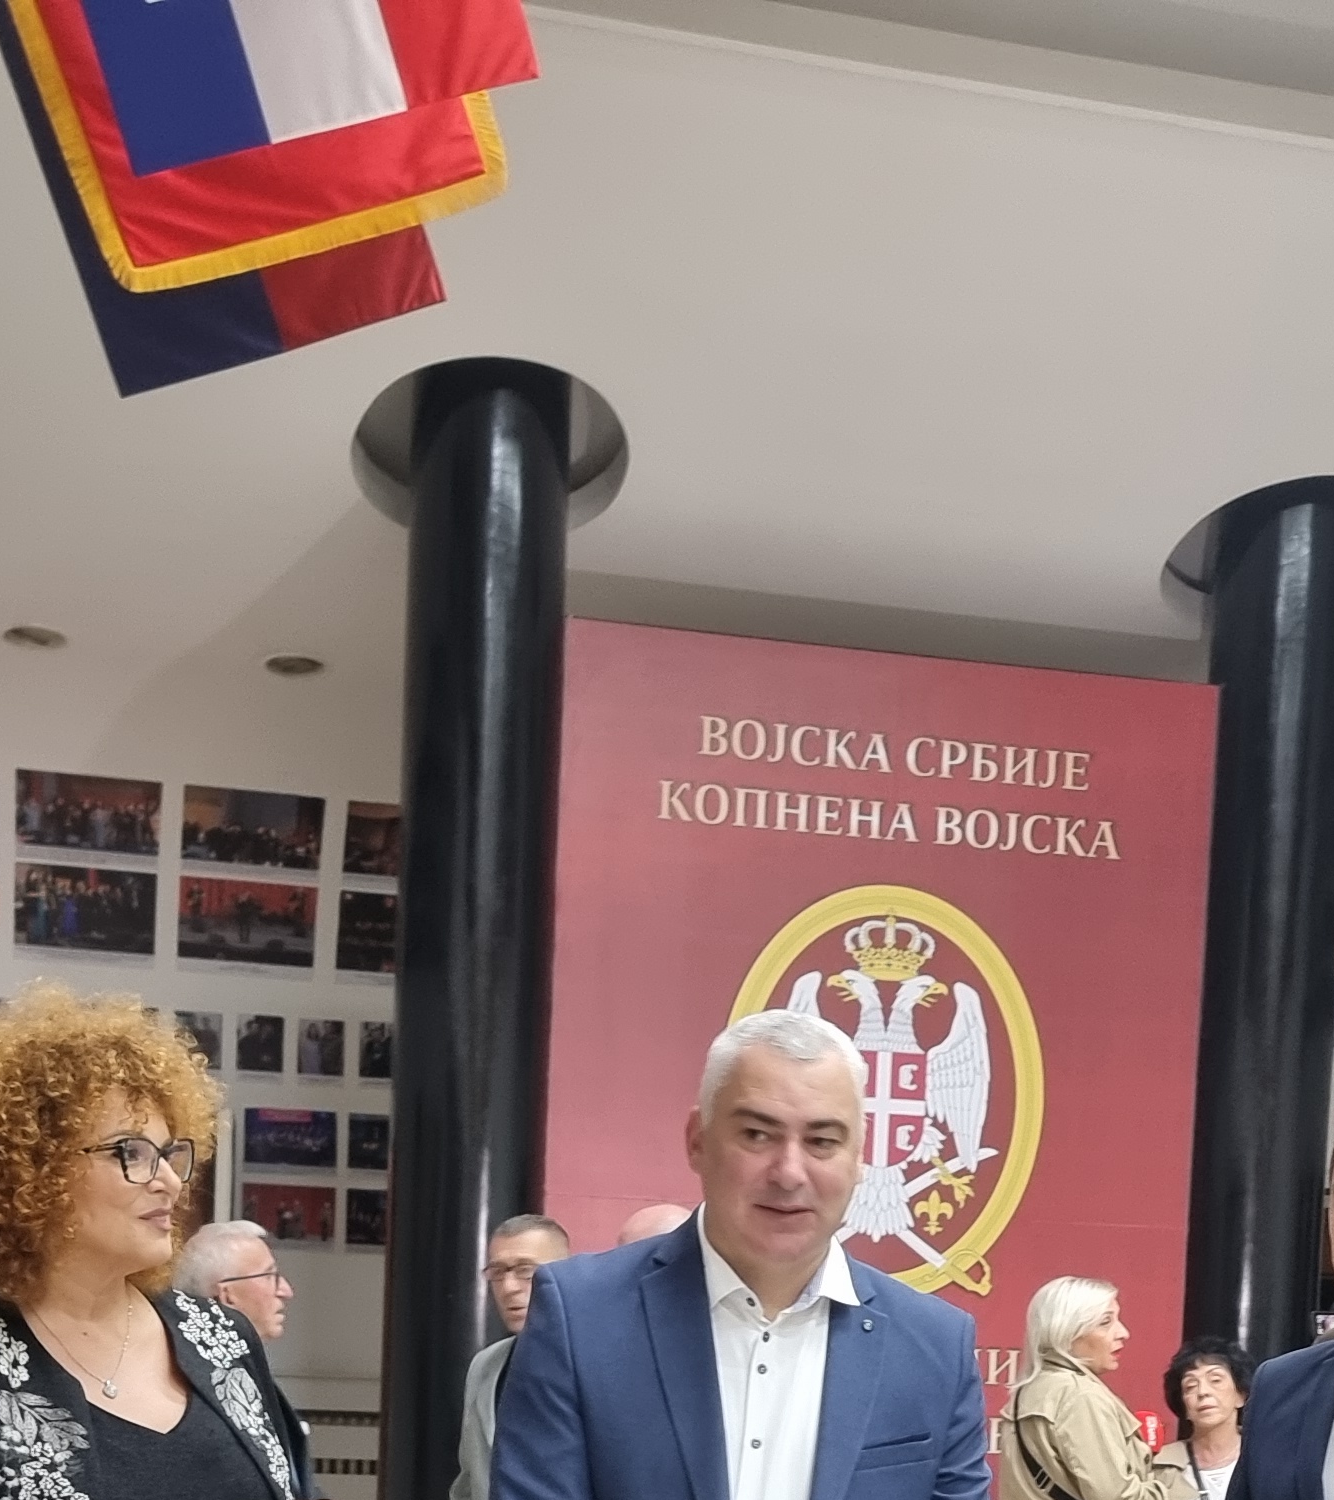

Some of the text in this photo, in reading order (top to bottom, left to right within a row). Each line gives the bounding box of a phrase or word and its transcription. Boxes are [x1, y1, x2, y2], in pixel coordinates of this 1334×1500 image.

[698, 715, 1091, 791] ВОЈСКА СРБИЈЕ
[657, 779, 1121, 860] КОПНЕНА ВОЈСКА
